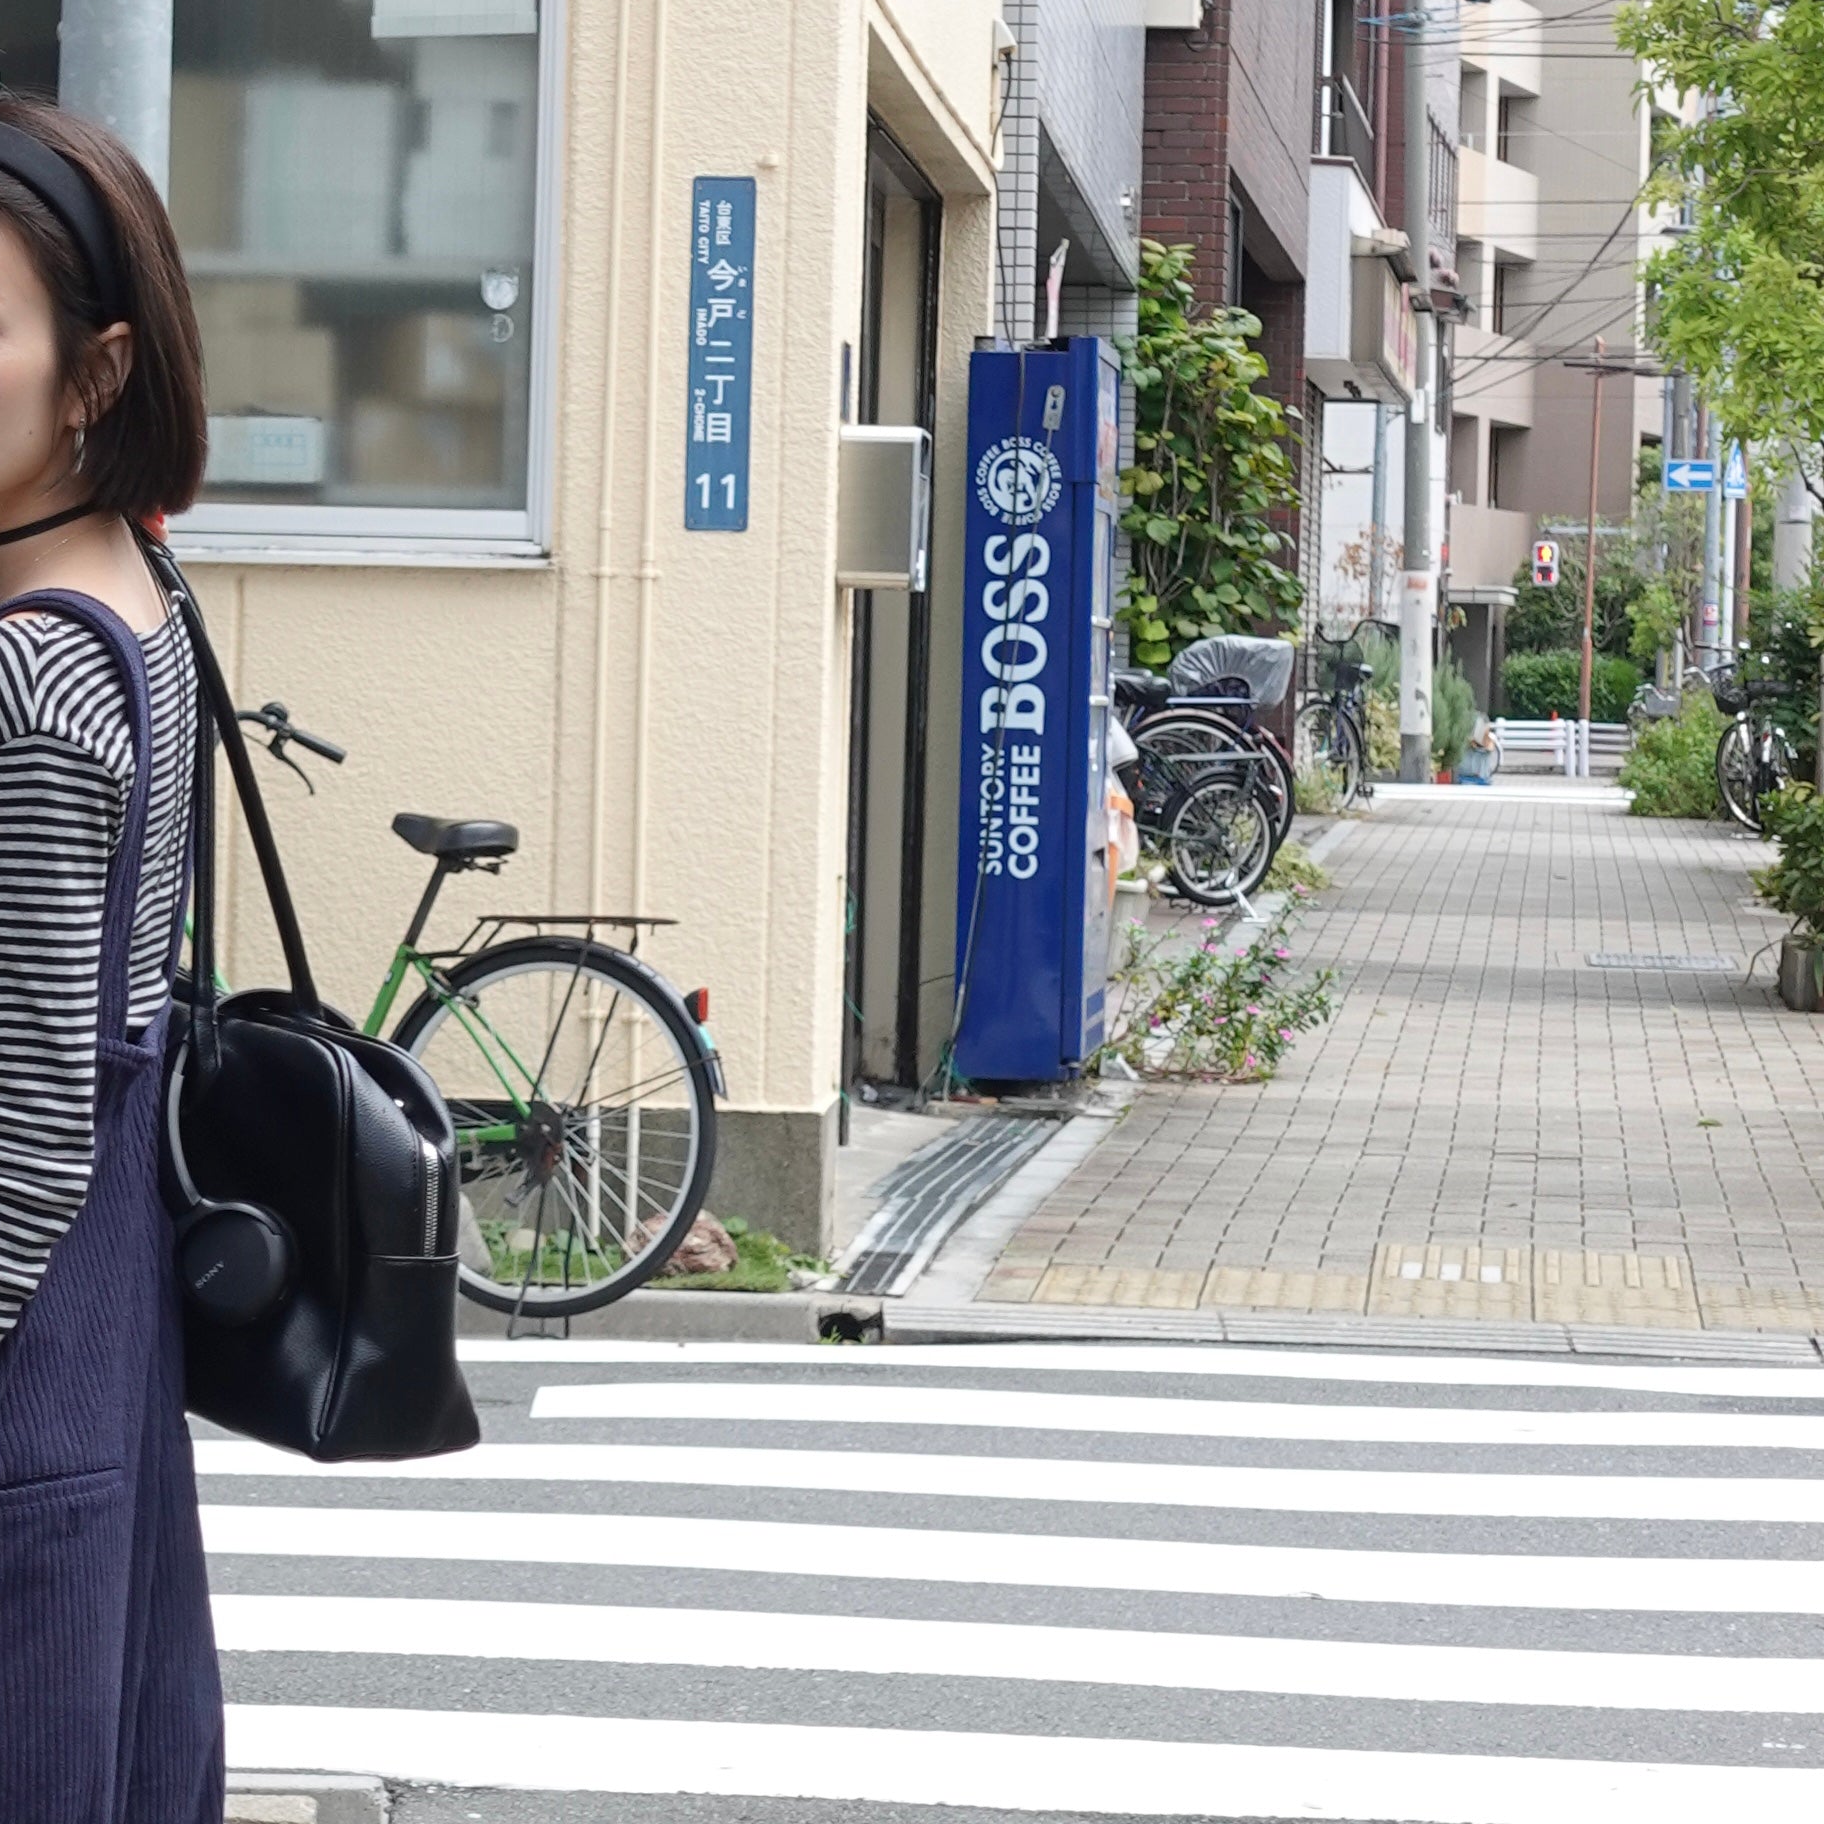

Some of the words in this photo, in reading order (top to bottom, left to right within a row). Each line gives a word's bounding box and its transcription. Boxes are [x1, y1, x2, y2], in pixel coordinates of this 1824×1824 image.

[697, 199, 711, 233] TAITO
[697, 236, 710, 264] CITY
[695, 308, 708, 346] IMADO
[704, 258, 740, 444] 今戸二丁目
[693, 388, 706, 443] 2-CHOME
[695, 473, 736, 509] 11
[980, 532, 1051, 736] BOSS
[1007, 744, 1042, 880] COFFEE
[195, 1260, 224, 1289] SONY
